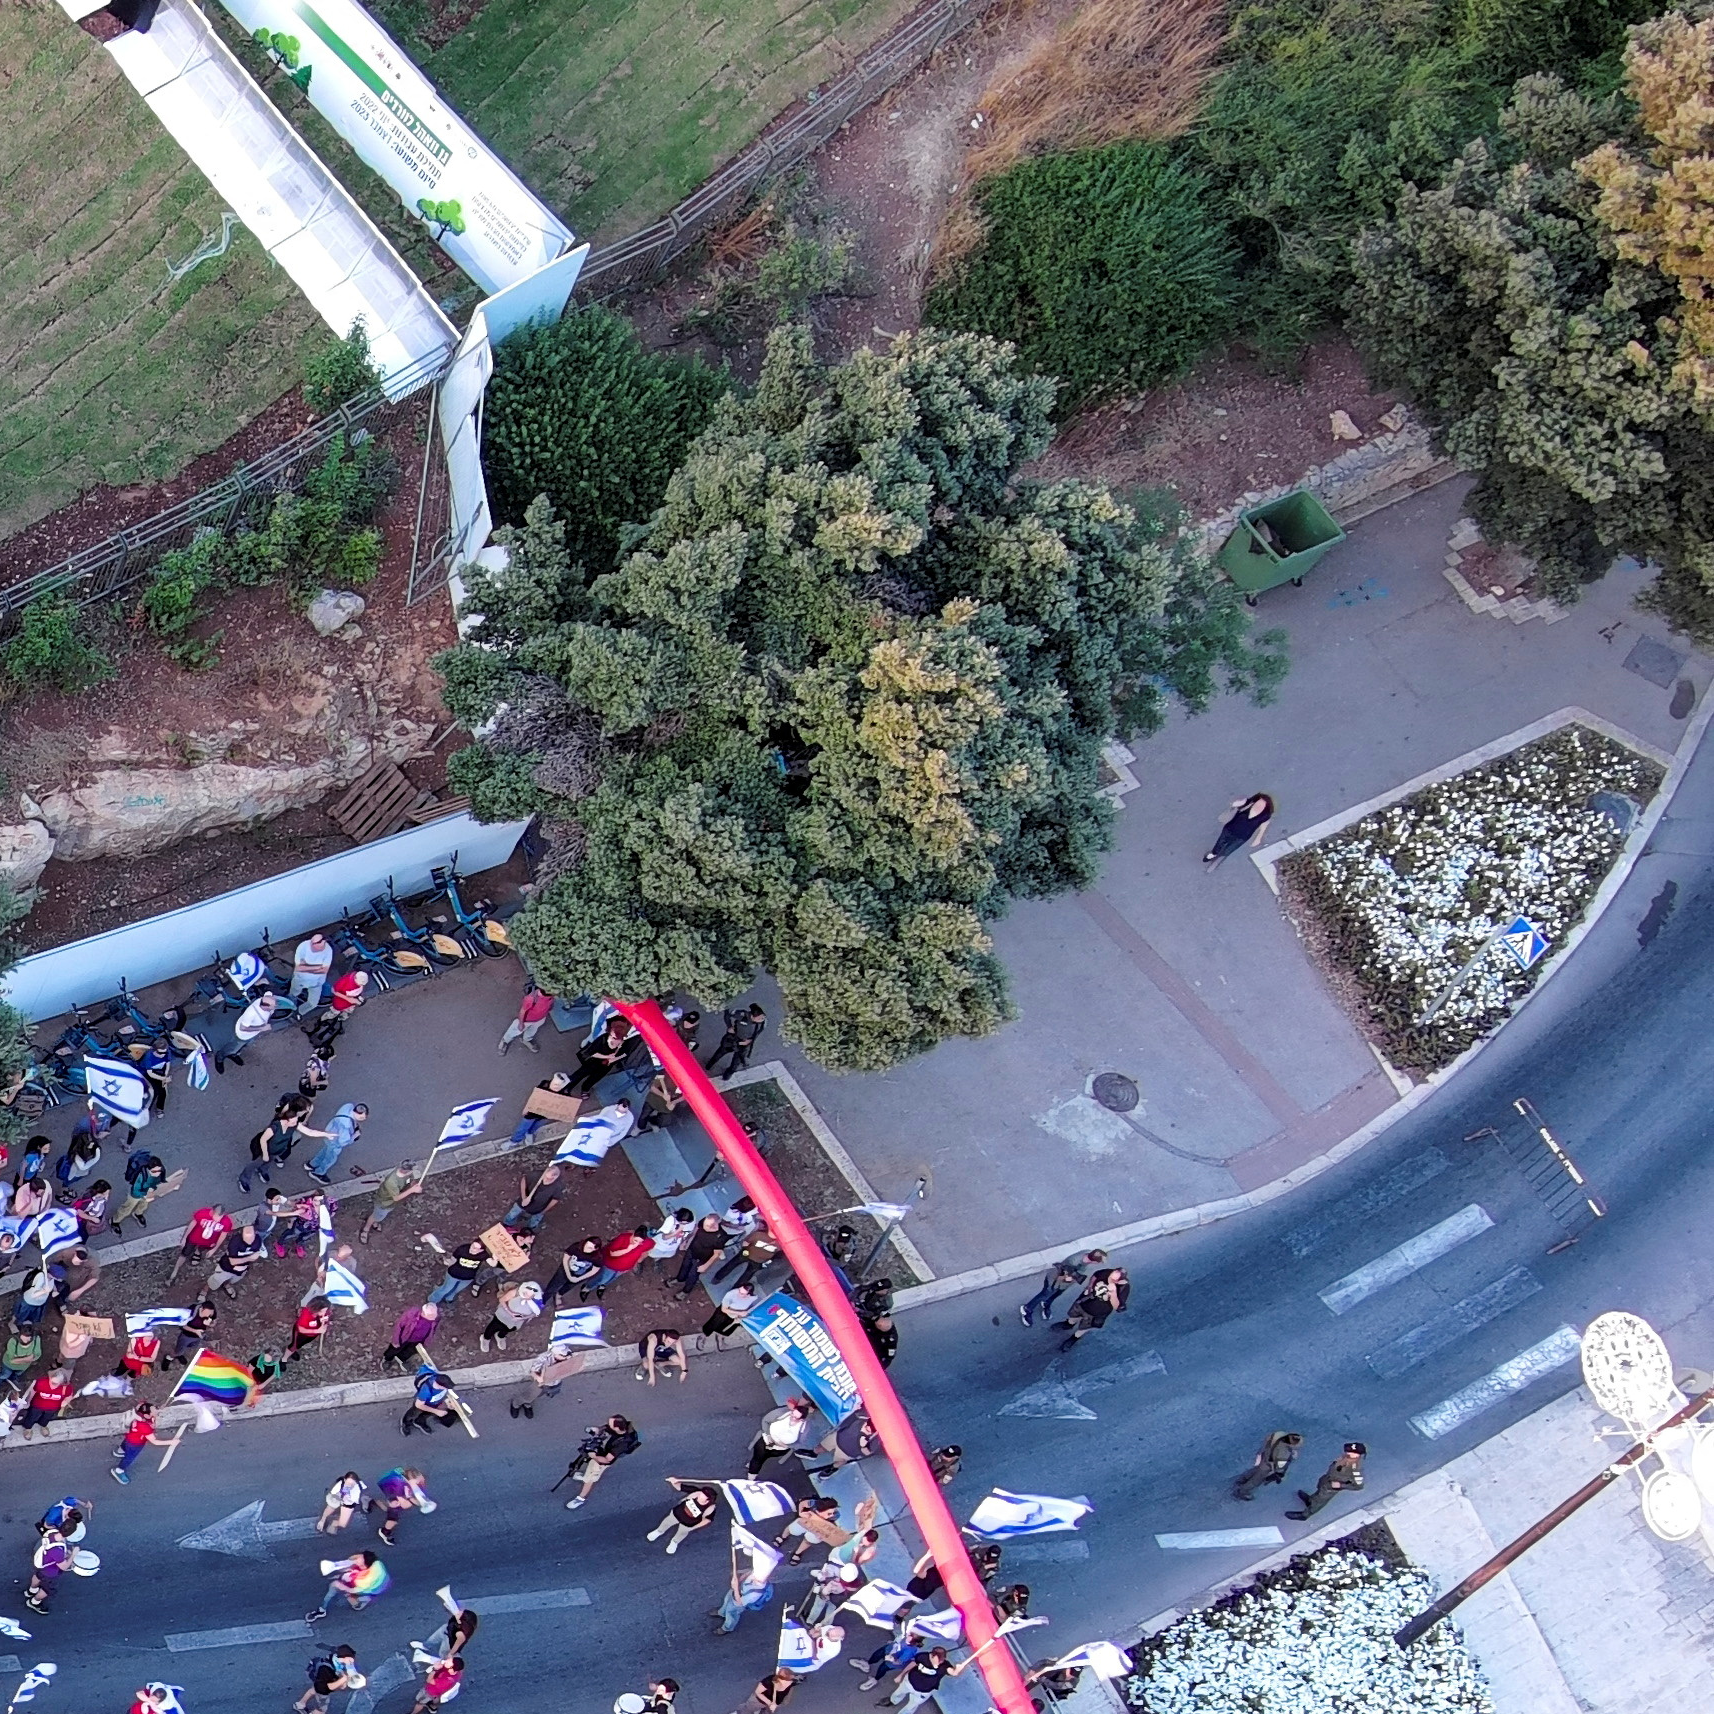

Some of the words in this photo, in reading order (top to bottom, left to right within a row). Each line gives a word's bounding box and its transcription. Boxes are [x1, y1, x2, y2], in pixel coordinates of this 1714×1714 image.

[350, 99, 370, 121] 2023
[359, 92, 379, 114] 2022
[418, 169, 437, 189] סיום
